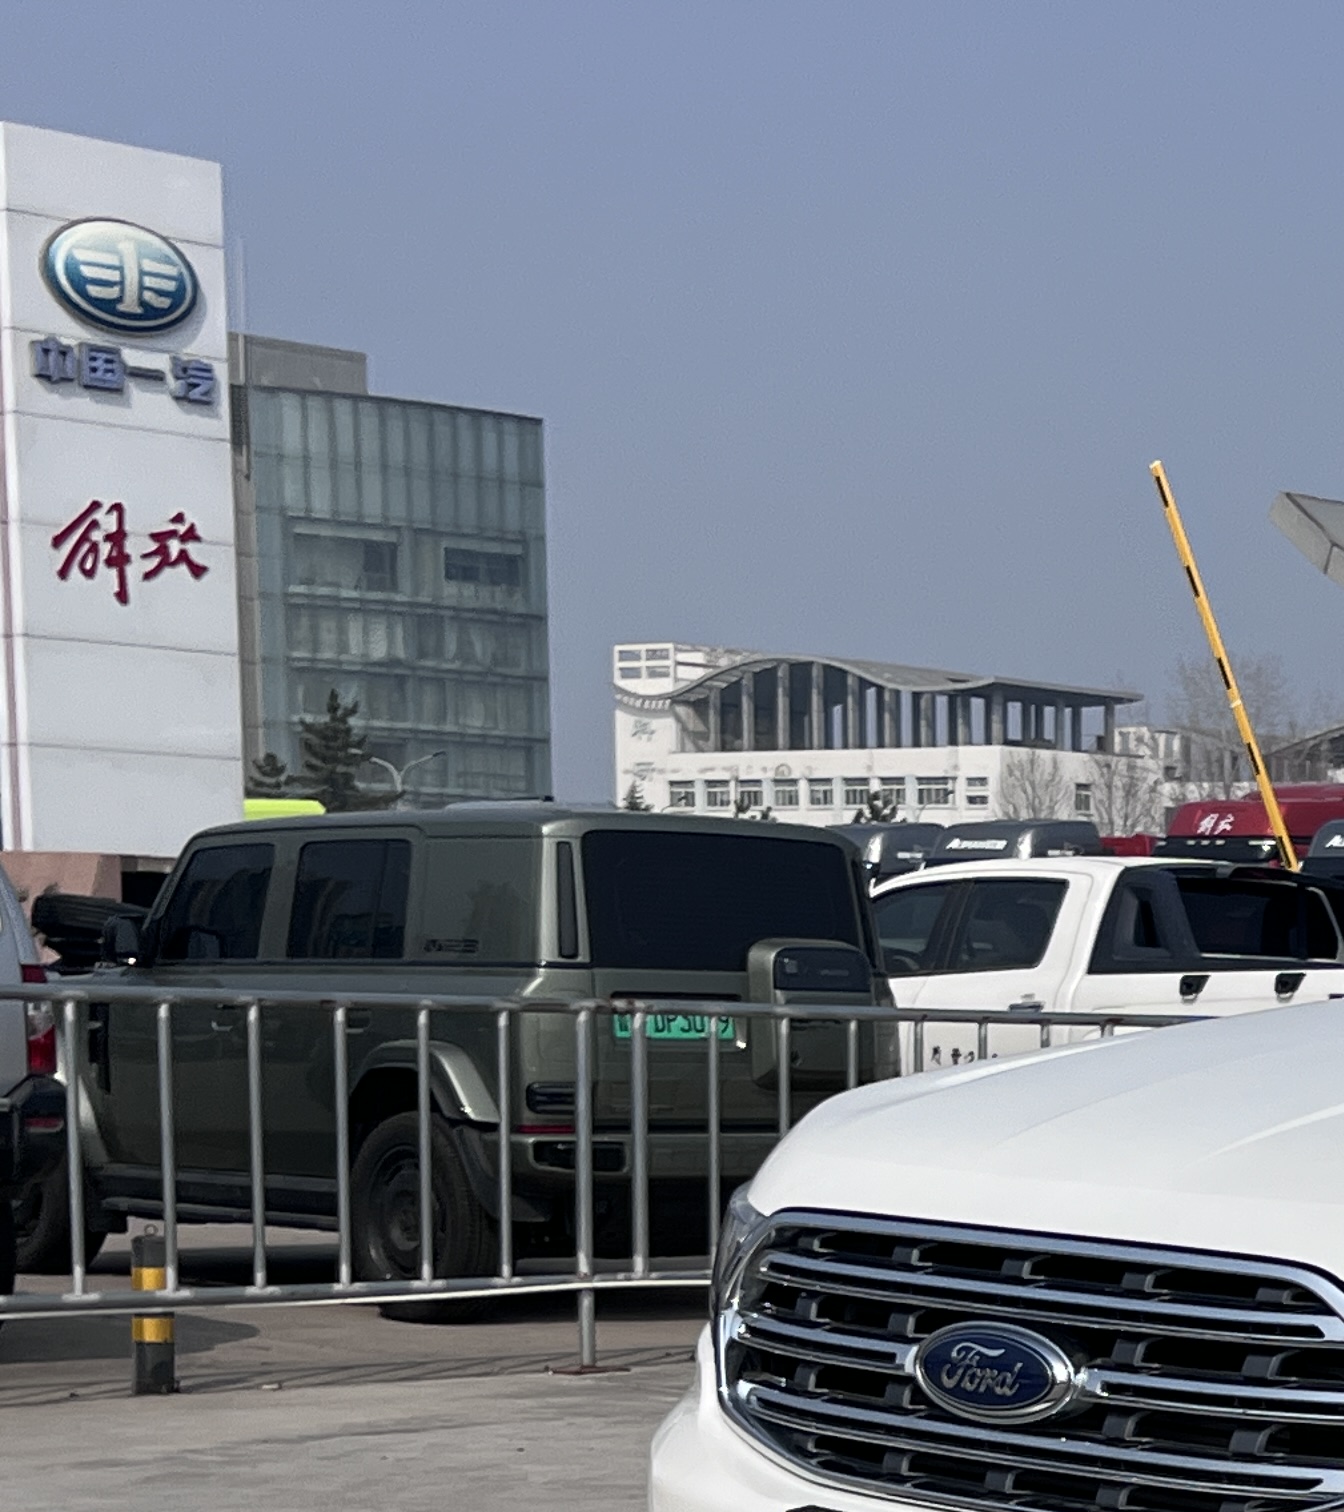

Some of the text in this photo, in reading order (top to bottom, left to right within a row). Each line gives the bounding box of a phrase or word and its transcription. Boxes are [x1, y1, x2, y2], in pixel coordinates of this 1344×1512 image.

[30, 337, 214, 405] 中国一汽
[940, 1341, 1024, 1397] Ford
